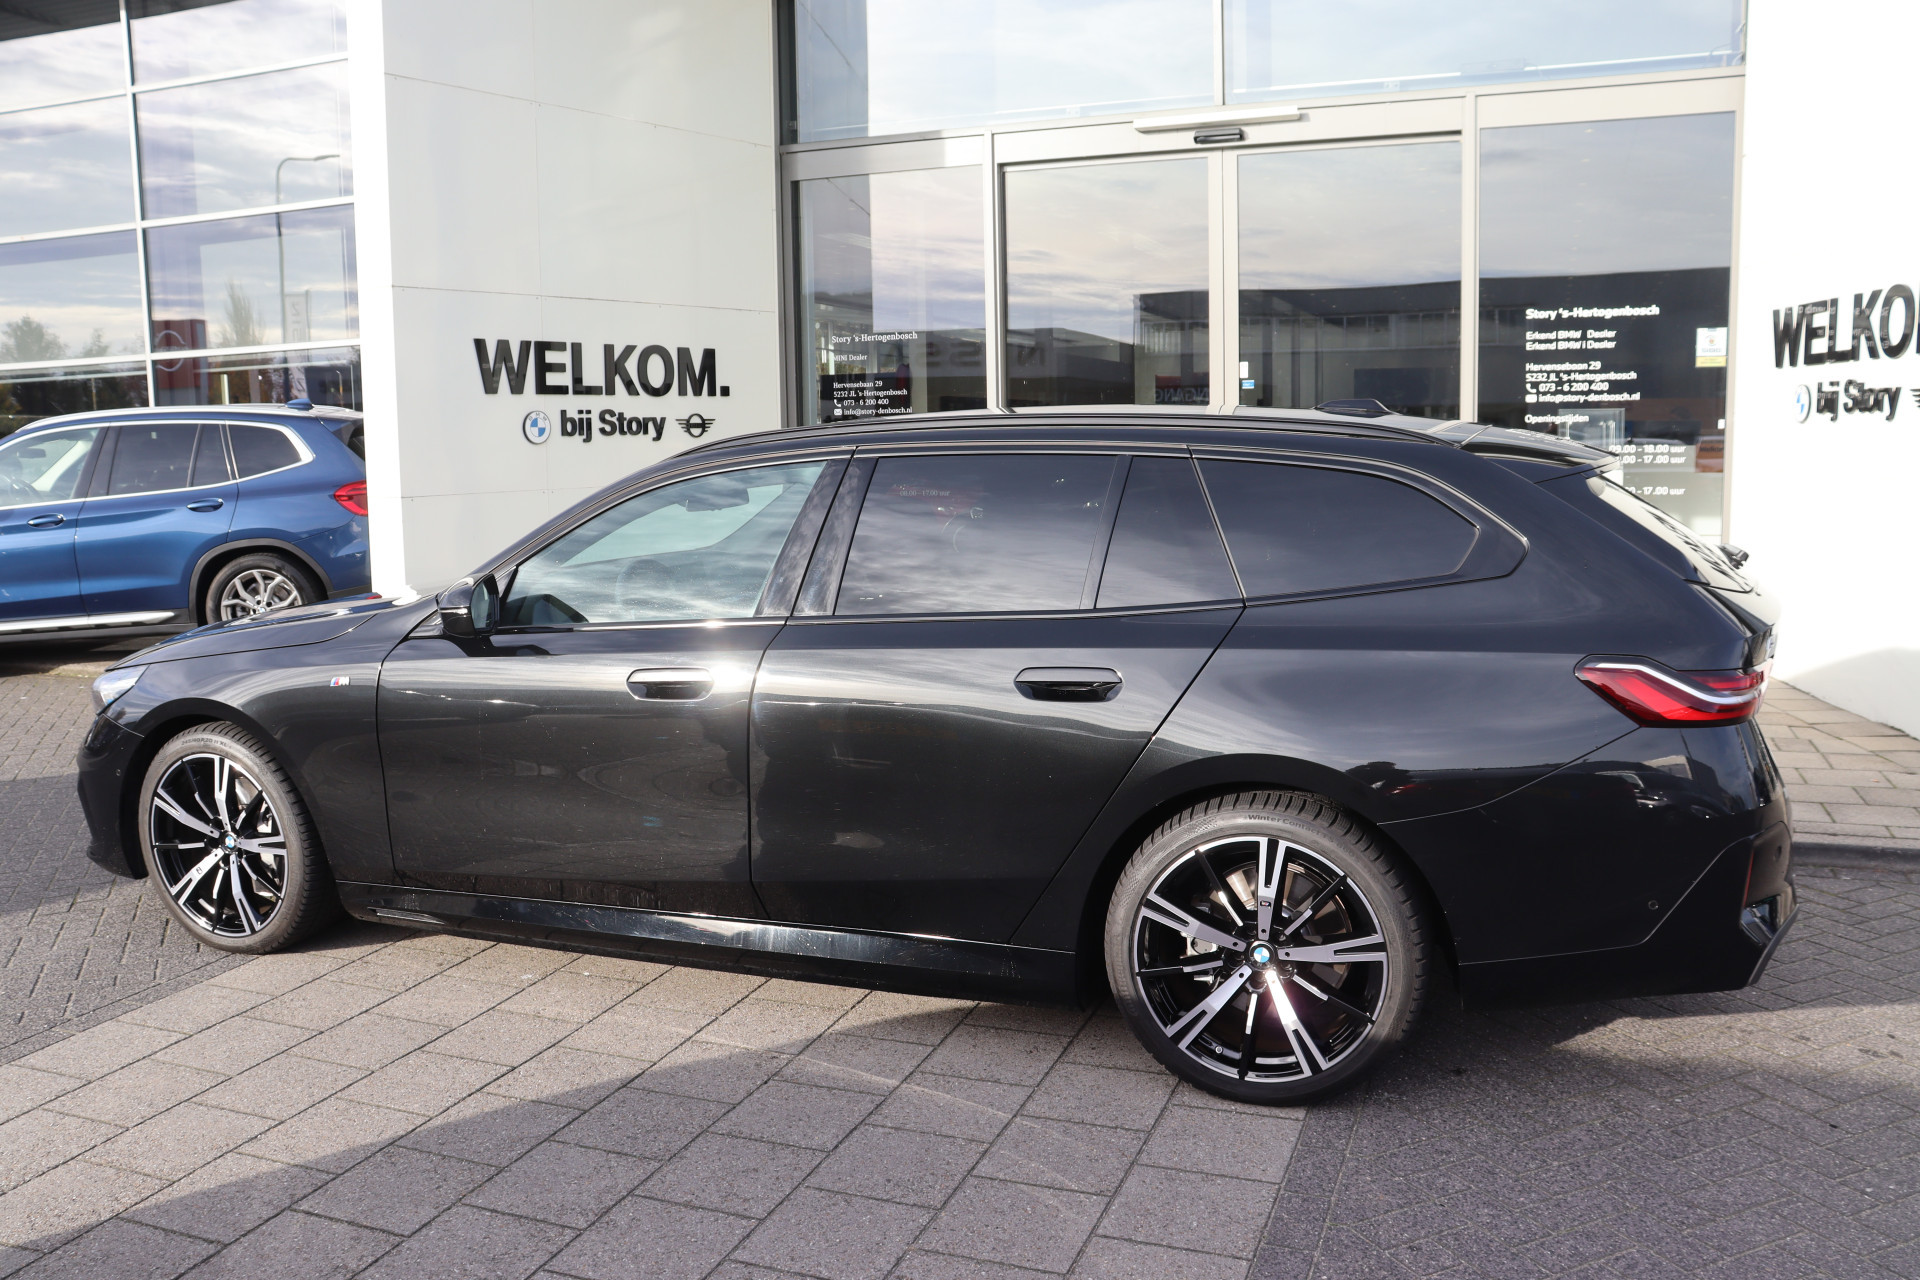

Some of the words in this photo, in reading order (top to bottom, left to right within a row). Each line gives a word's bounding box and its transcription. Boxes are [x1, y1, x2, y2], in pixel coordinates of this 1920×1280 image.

[1525, 308, 1558, 321] Story
[1772, 283, 1920, 369] WELKO
[831, 335, 851, 345] Story
[1525, 331, 1556, 340] Erkend
[1557, 330, 1582, 340] BMW
[1586, 329, 1617, 339] Dealer
[1525, 342, 1556, 351] Erkend
[1557, 341, 1582, 350] BMW
[1586, 340, 1617, 349] Dealer
[473, 338, 731, 397] WELKOM.
[1525, 362, 1588, 372] Hervensebaan
[1588, 361, 1602, 370] 29
[1525, 373, 1548, 382] 5232
[1548, 372, 1559, 382] JL
[1538, 383, 1556, 392] 073
[1563, 383, 1570, 391] 6
[1571, 383, 1589, 391] 200
[1590, 382, 1609, 391] 400
[1538, 392, 1641, 403] info@story-denbosch.nl
[1816, 381, 1840, 422] bij
[1843, 379, 1902, 422] Story
[843, 407, 913, 416] info@story-denbosch.nl
[1523, 414, 1590, 424] Openingstijden
[560, 409, 593, 443] bij
[598, 408, 666, 442] Story
[1643, 444, 1669, 453] 18.00
